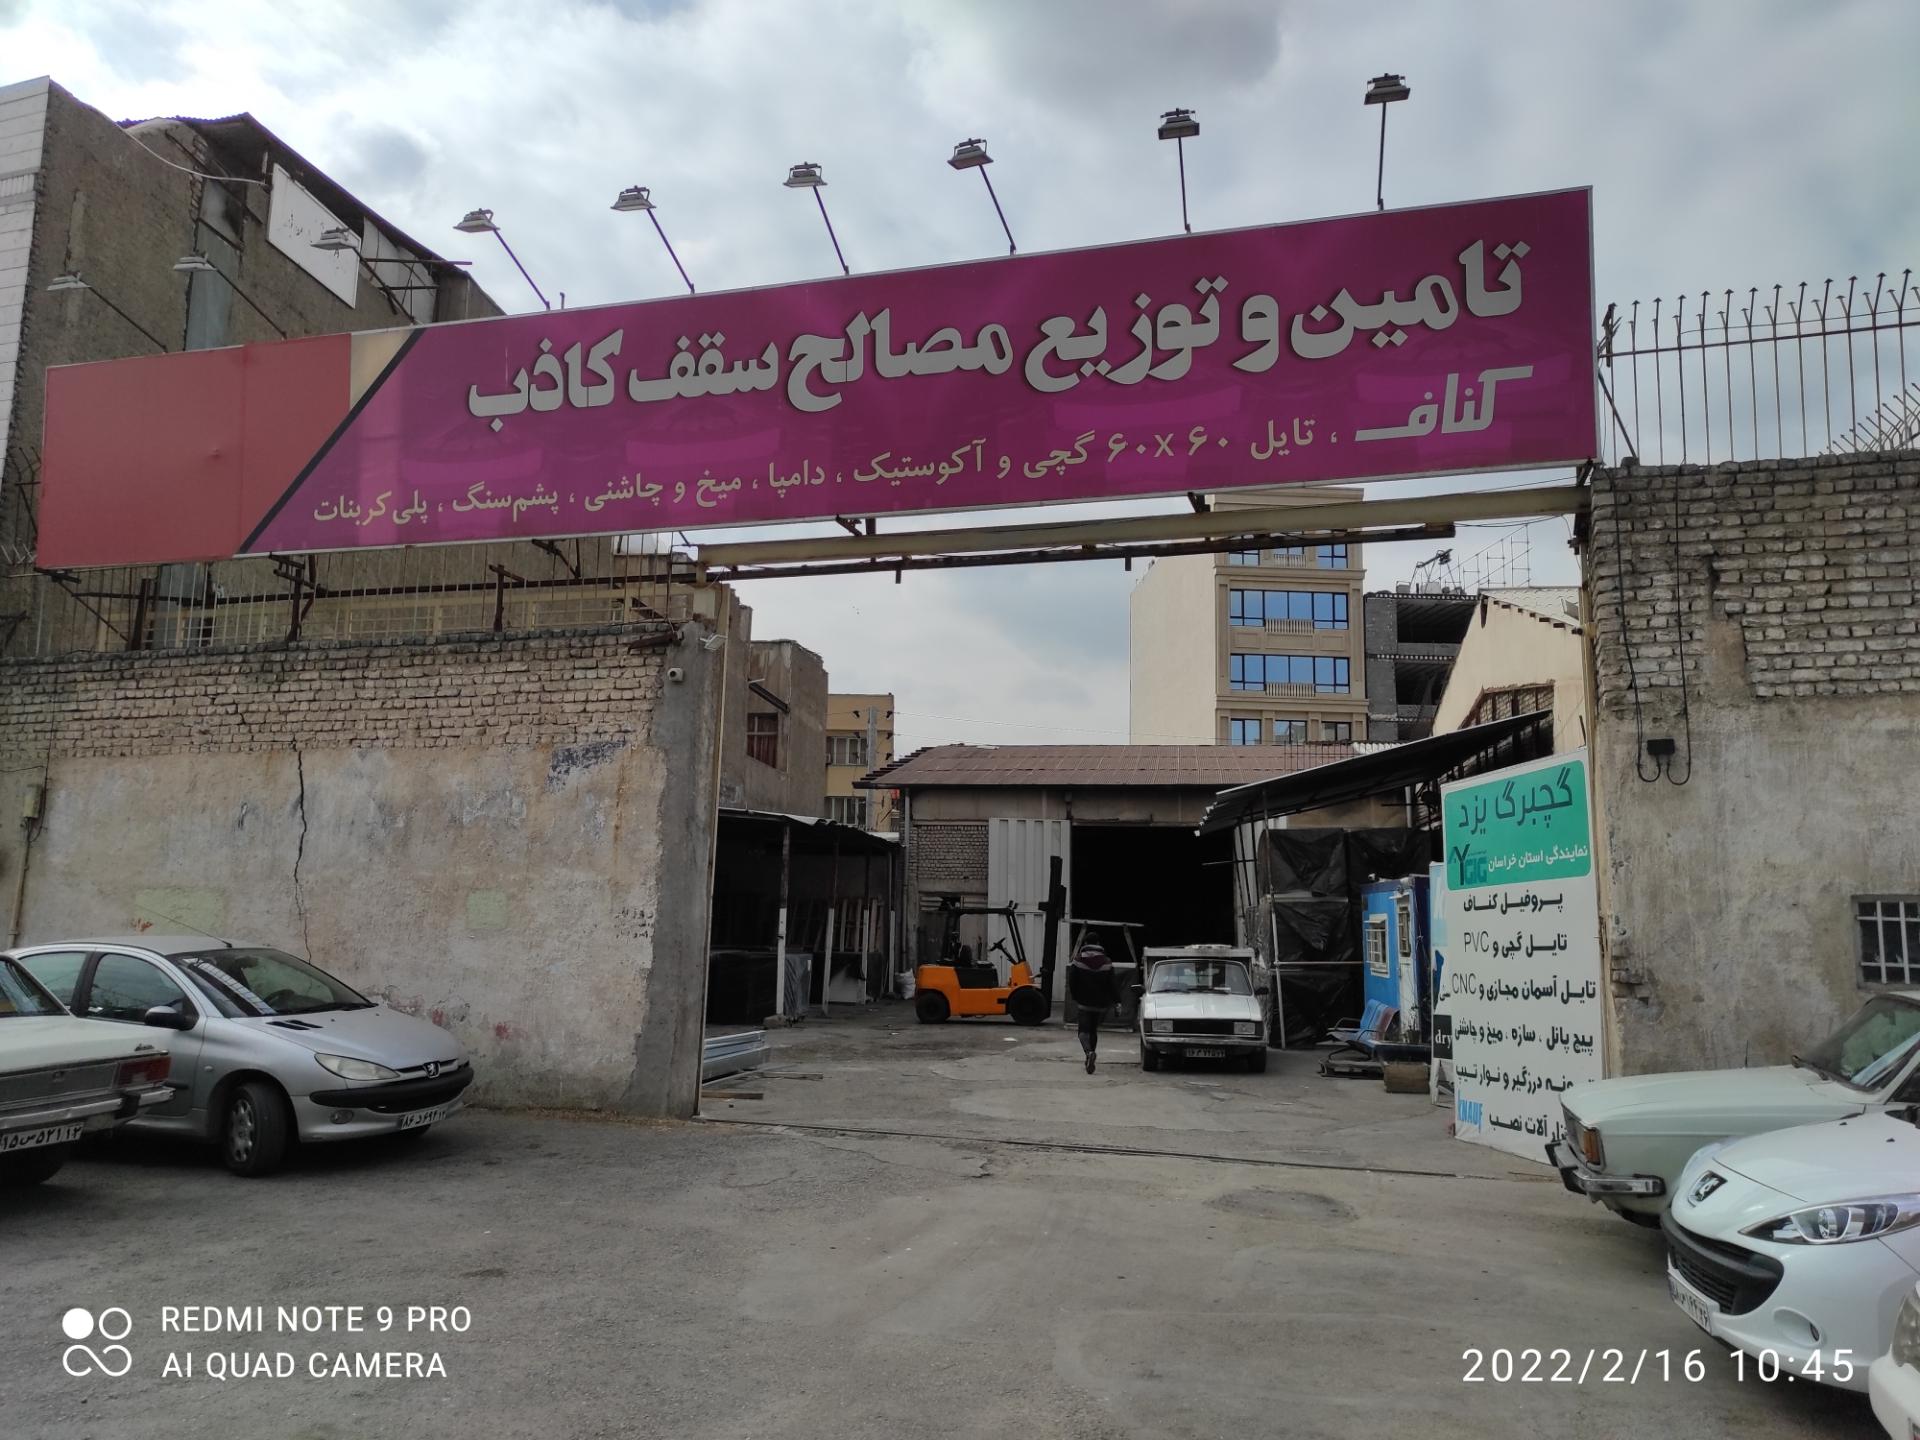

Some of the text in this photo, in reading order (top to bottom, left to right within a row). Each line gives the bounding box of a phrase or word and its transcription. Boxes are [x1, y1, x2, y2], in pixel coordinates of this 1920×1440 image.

[468, 239, 1531, 432] تامین و توزیع مصالح سقف کاذب
[1355, 365, 1533, 442] کناف
[1250, 417, 1316, 460] تایل
[853, 438, 986, 486] آکوستیک
[996, 454, 1011, 478] و
[1023, 430, 1095, 479] گچی
[672, 479, 686, 503] و
[695, 470, 742, 508] میخ
[768, 459, 825, 498] دامپا
[584, 472, 663, 512] چاشنی
[1458, 767, 1573, 835] گچبرگ یزد
[1488, 844, 1588, 872] نمایندگی استان خراسان
[1463, 889, 1563, 915] پروفیل کناف
[1464, 930, 1567, 960] تایل گچی و PVC
[1451, 973, 1477, 995] CNC
[1479, 983, 1485, 1000] و
[1486, 978, 1519, 1001] مجازی
[1521, 975, 1557, 1000] آسمان
[1561, 980, 1596, 1004] تایل
[1454, 1017, 1477, 1044] چاشنی
[1486, 1021, 1503, 1045] میخ
[1511, 1024, 1536, 1047] سازه
[1546, 1026, 1569, 1053] پانل
[1572, 1032, 1593, 1056] پیچ
[1479, 1064, 1500, 1087] نوار
[1511, 1066, 1542, 1095] درزگیر
[1489, 1112, 1522, 1131] نصب
[1524, 1115, 1548, 1137] آلات
